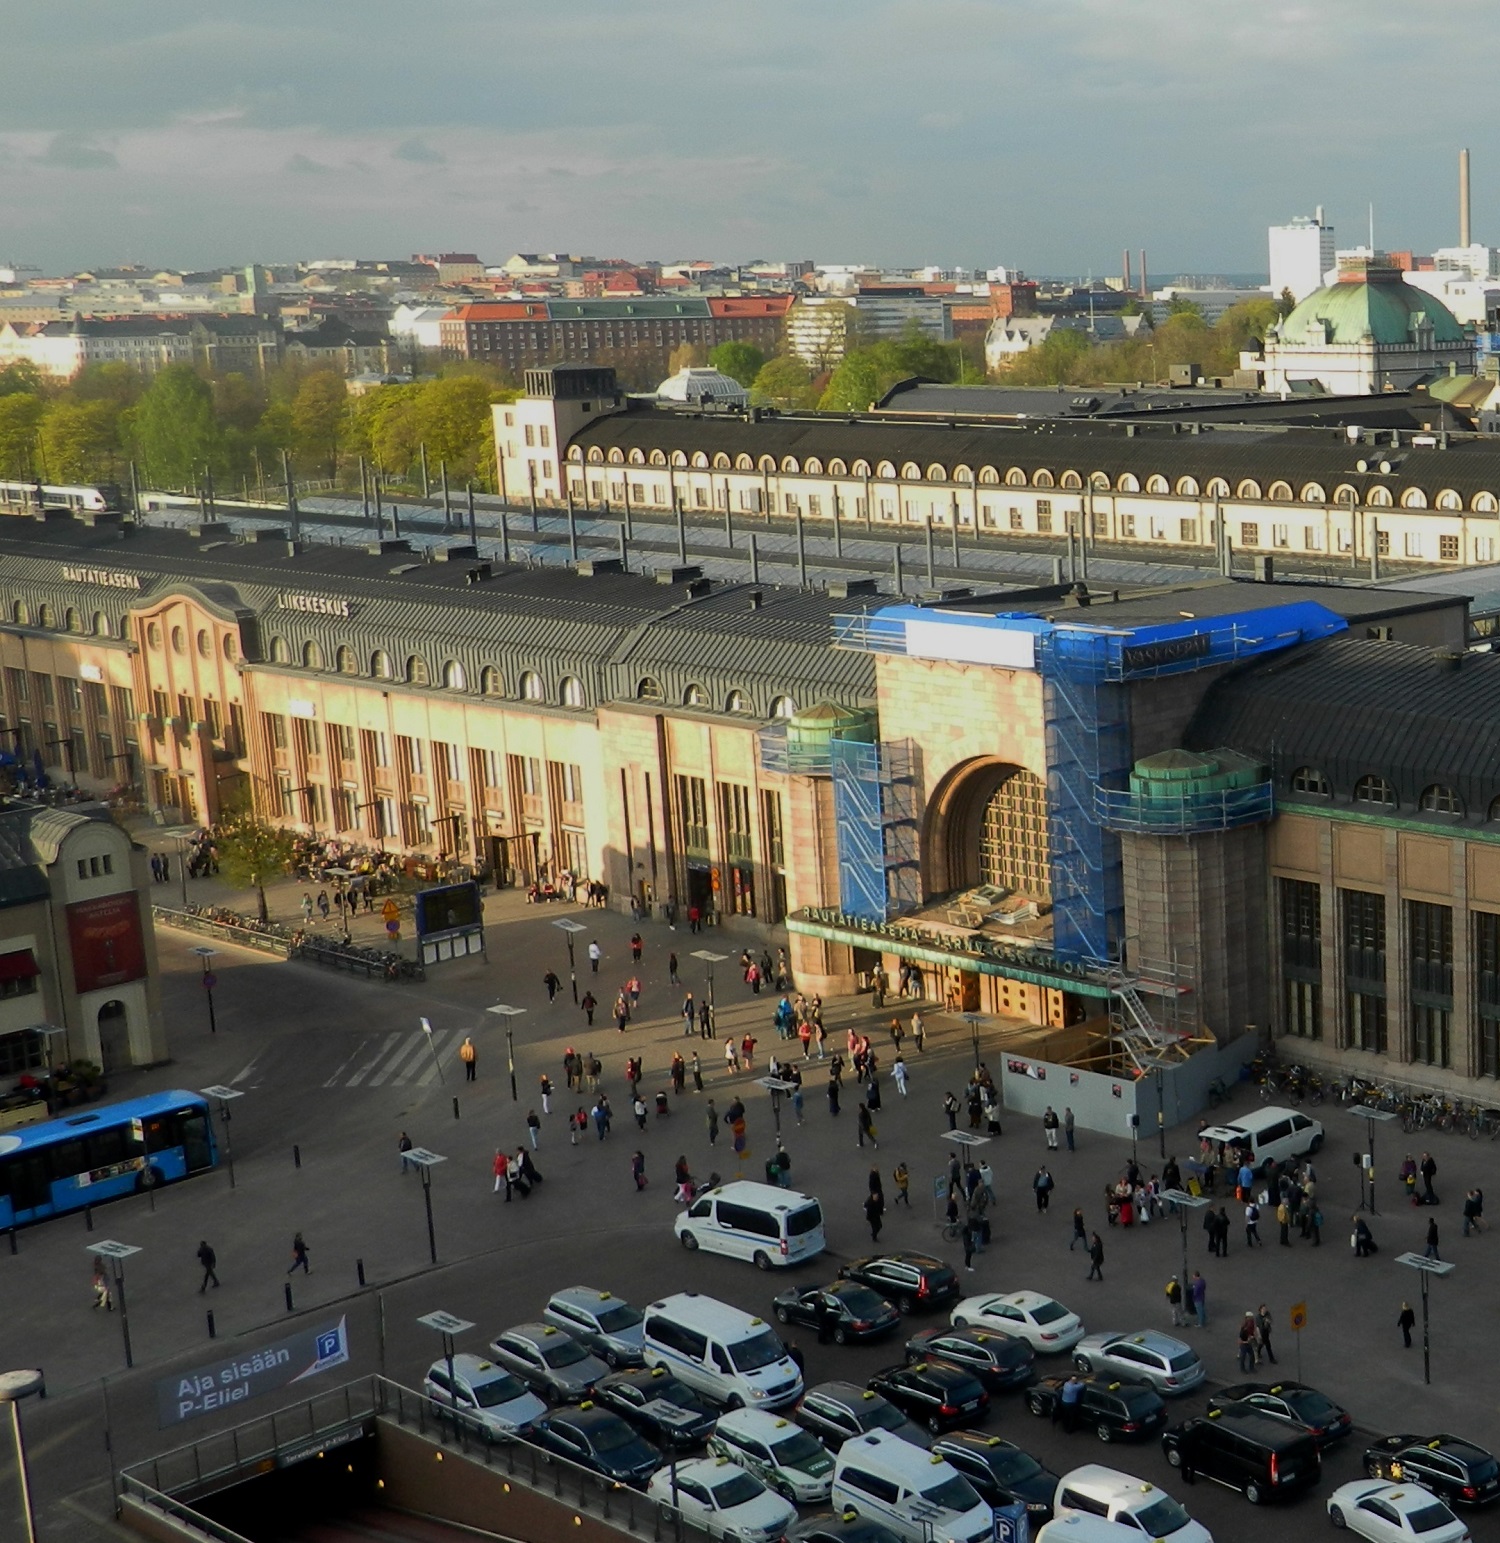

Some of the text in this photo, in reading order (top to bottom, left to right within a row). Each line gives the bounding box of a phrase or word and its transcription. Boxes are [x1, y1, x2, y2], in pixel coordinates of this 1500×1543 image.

[61, 566, 141, 590] RAUTATIEASEMA
[277, 593, 349, 618] LIIKEKESKUS
[803, 905, 922, 942] RAUTATIEASEMA
[324, 1336, 336, 1354] P
[178, 1348, 290, 1398] Aja sisään
[179, 1381, 250, 1419] P-Eliel
[999, 1522, 1010, 1542] P
